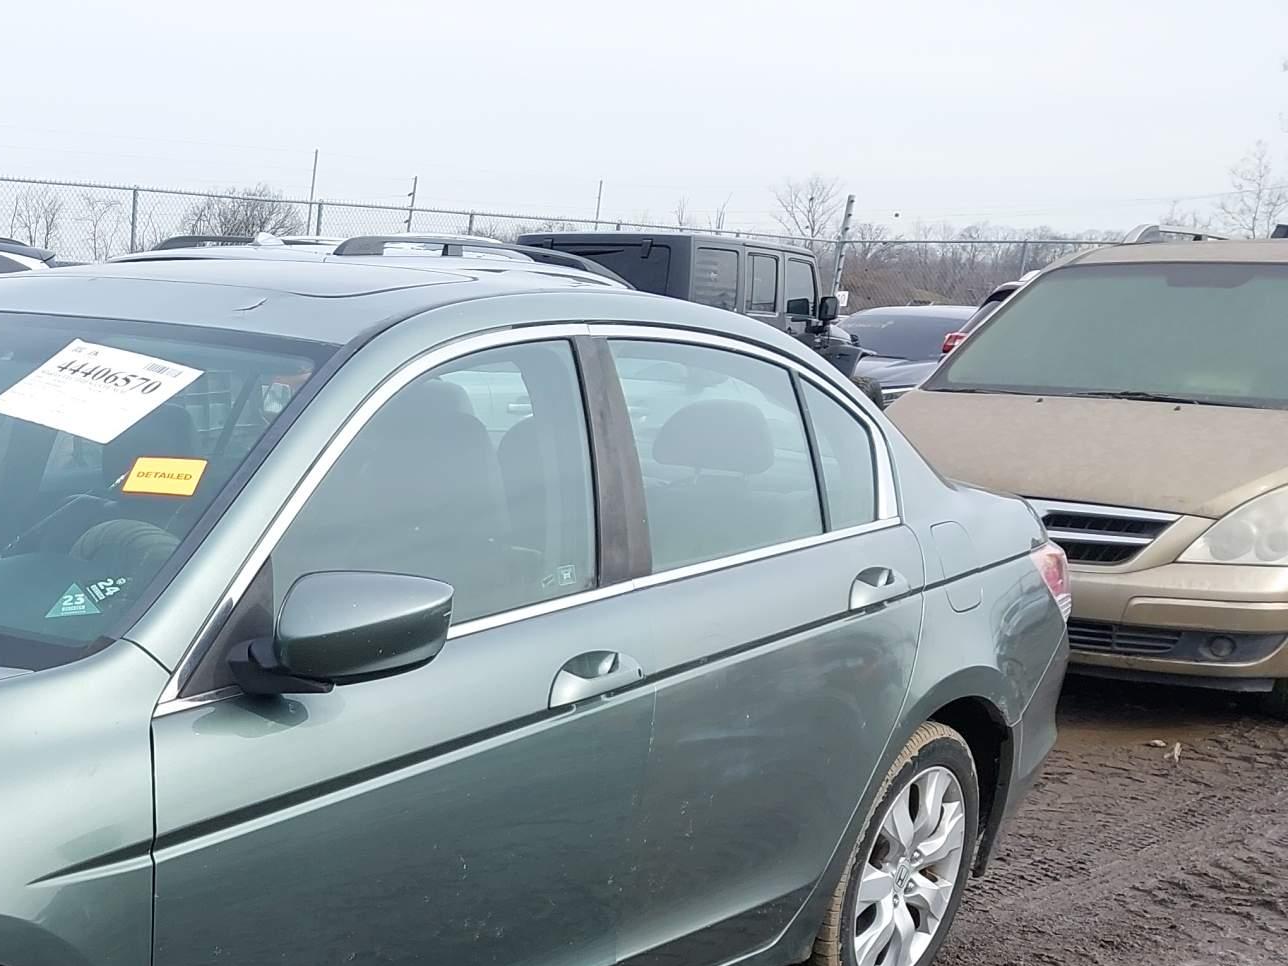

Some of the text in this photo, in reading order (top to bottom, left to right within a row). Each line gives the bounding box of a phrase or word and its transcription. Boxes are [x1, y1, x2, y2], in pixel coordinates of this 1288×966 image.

[57, 359, 162, 395] 44406570
[136, 471, 193, 481] DETAILED
[97, 578, 121, 597] 24
[62, 593, 85, 606] 23
